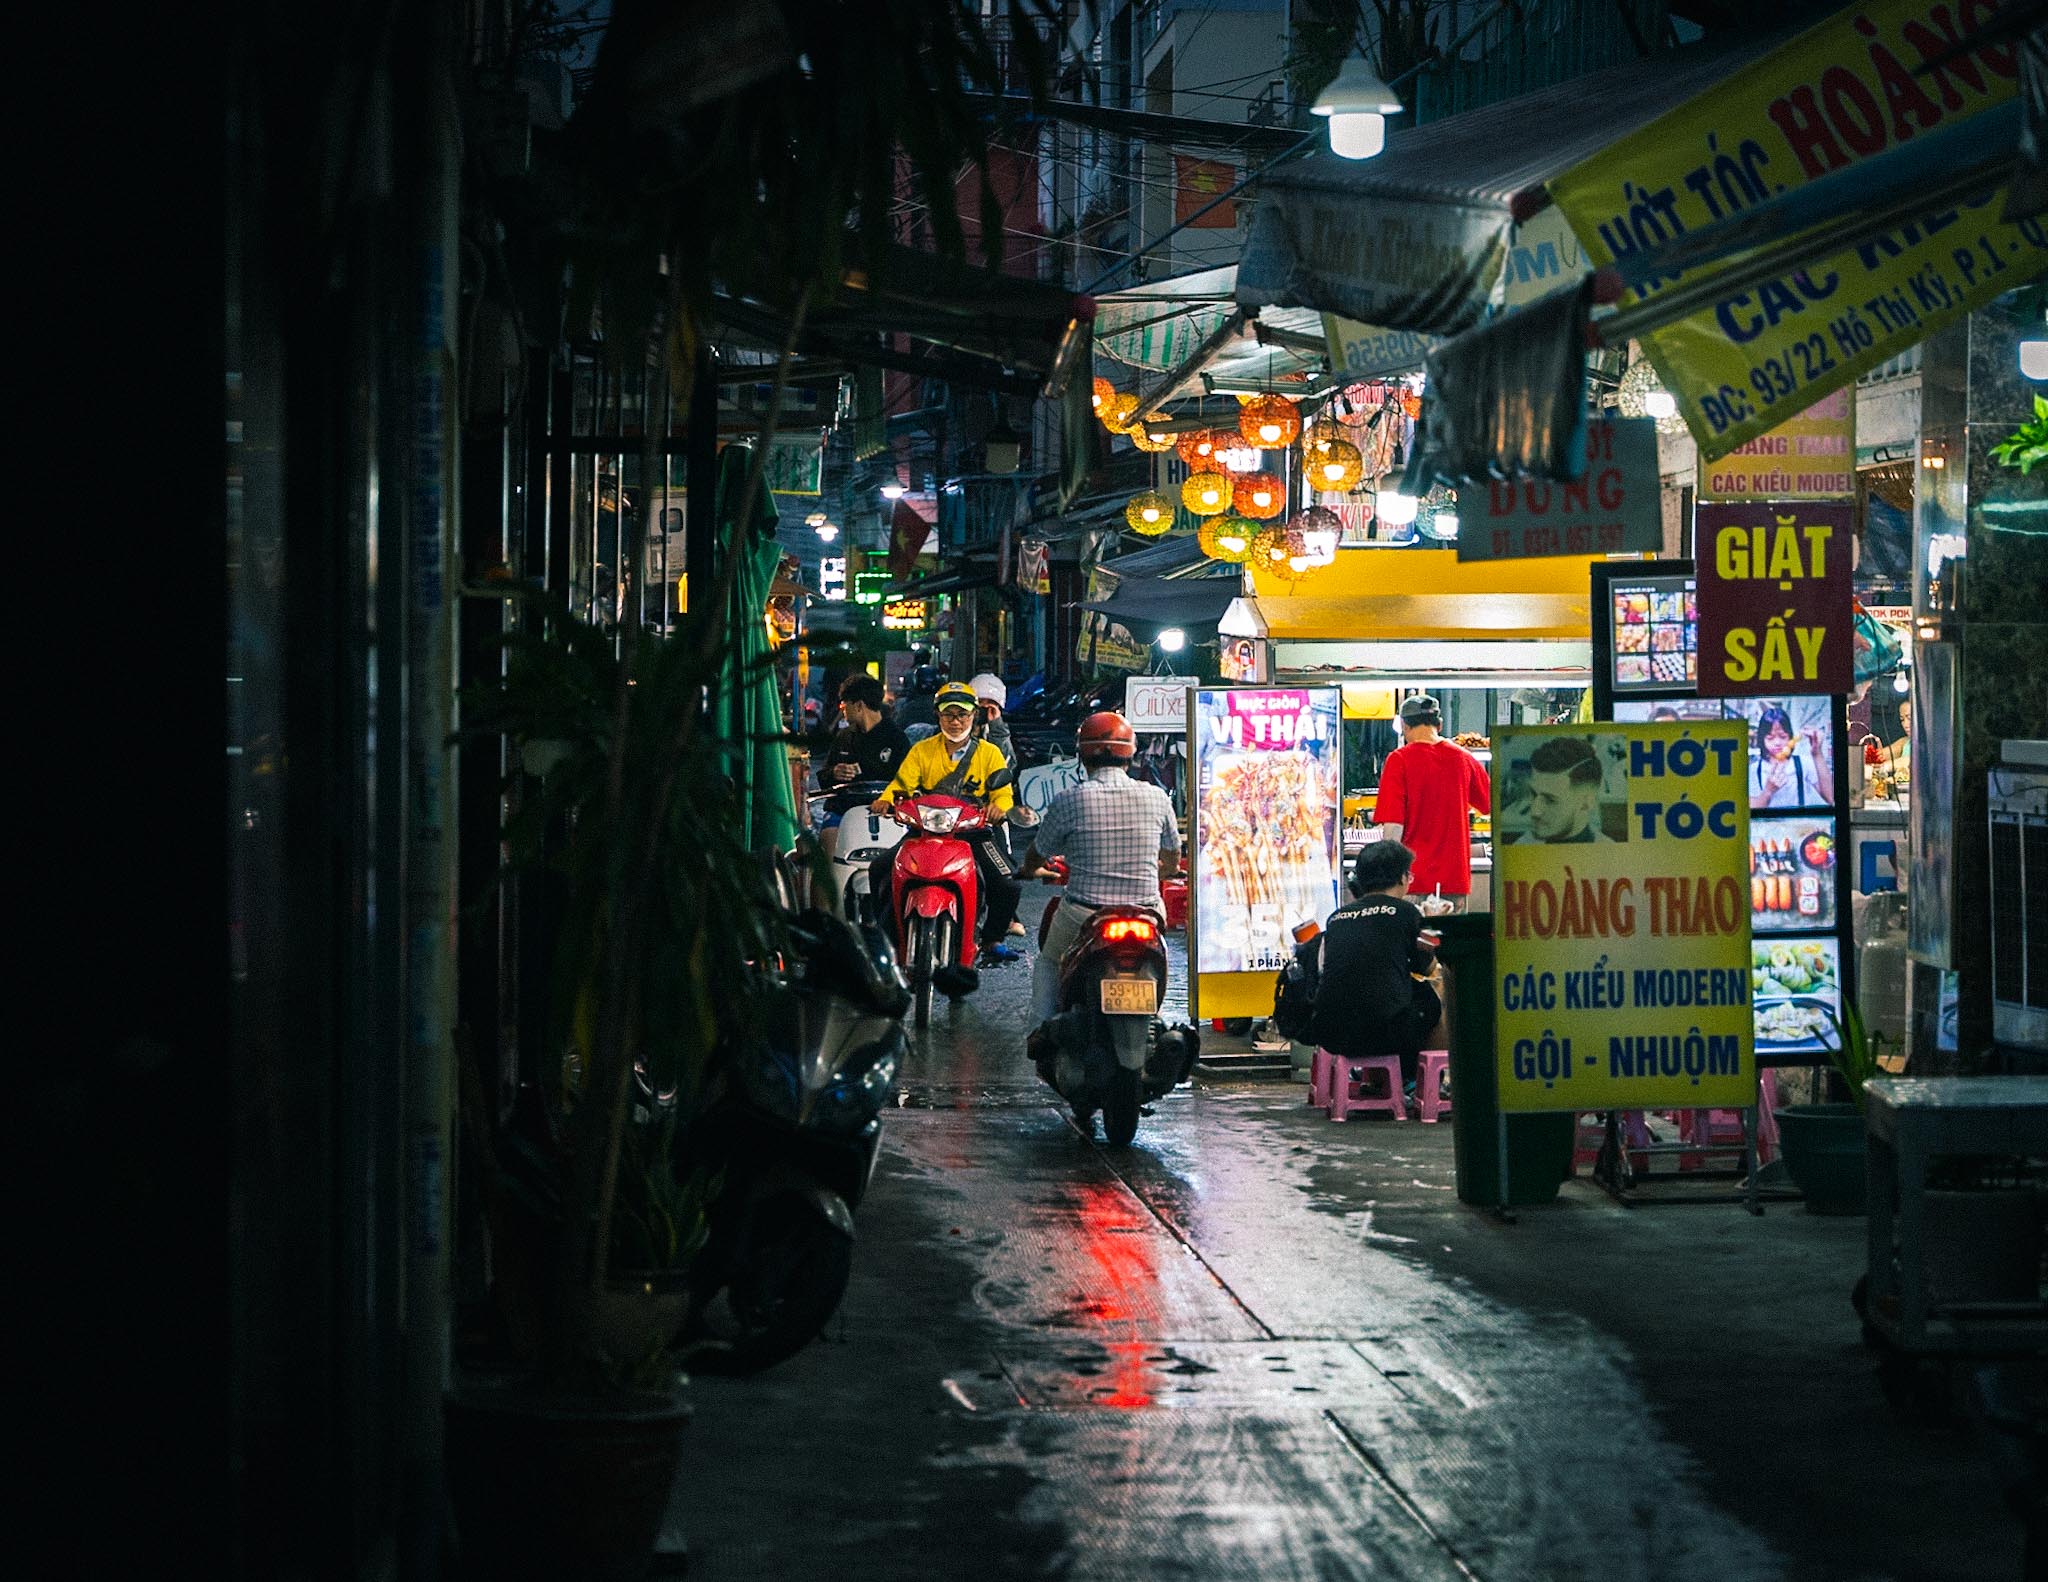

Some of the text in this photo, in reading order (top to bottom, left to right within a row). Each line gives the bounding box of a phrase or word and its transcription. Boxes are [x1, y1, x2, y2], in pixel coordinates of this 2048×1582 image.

[1751, 333, 1836, 405] 93/22
[1865, 289, 1922, 333] Thị
[1712, 471, 1747, 493] CÁC
[1716, 514, 1833, 591] GIẶT
[1724, 608, 1826, 682] SẤY
[1208, 705, 1327, 749] VỊ THÁI
[1629, 730, 1739, 777] HỚT
[1634, 793, 1737, 840] TÓC
[1503, 865, 1743, 940] HOÀNG THAO
[1503, 954, 1748, 1011] CÁC KIỂU MODERN
[1513, 1029, 1572, 1089] GỘI
[1608, 1026, 1740, 1086] NHUỘM
